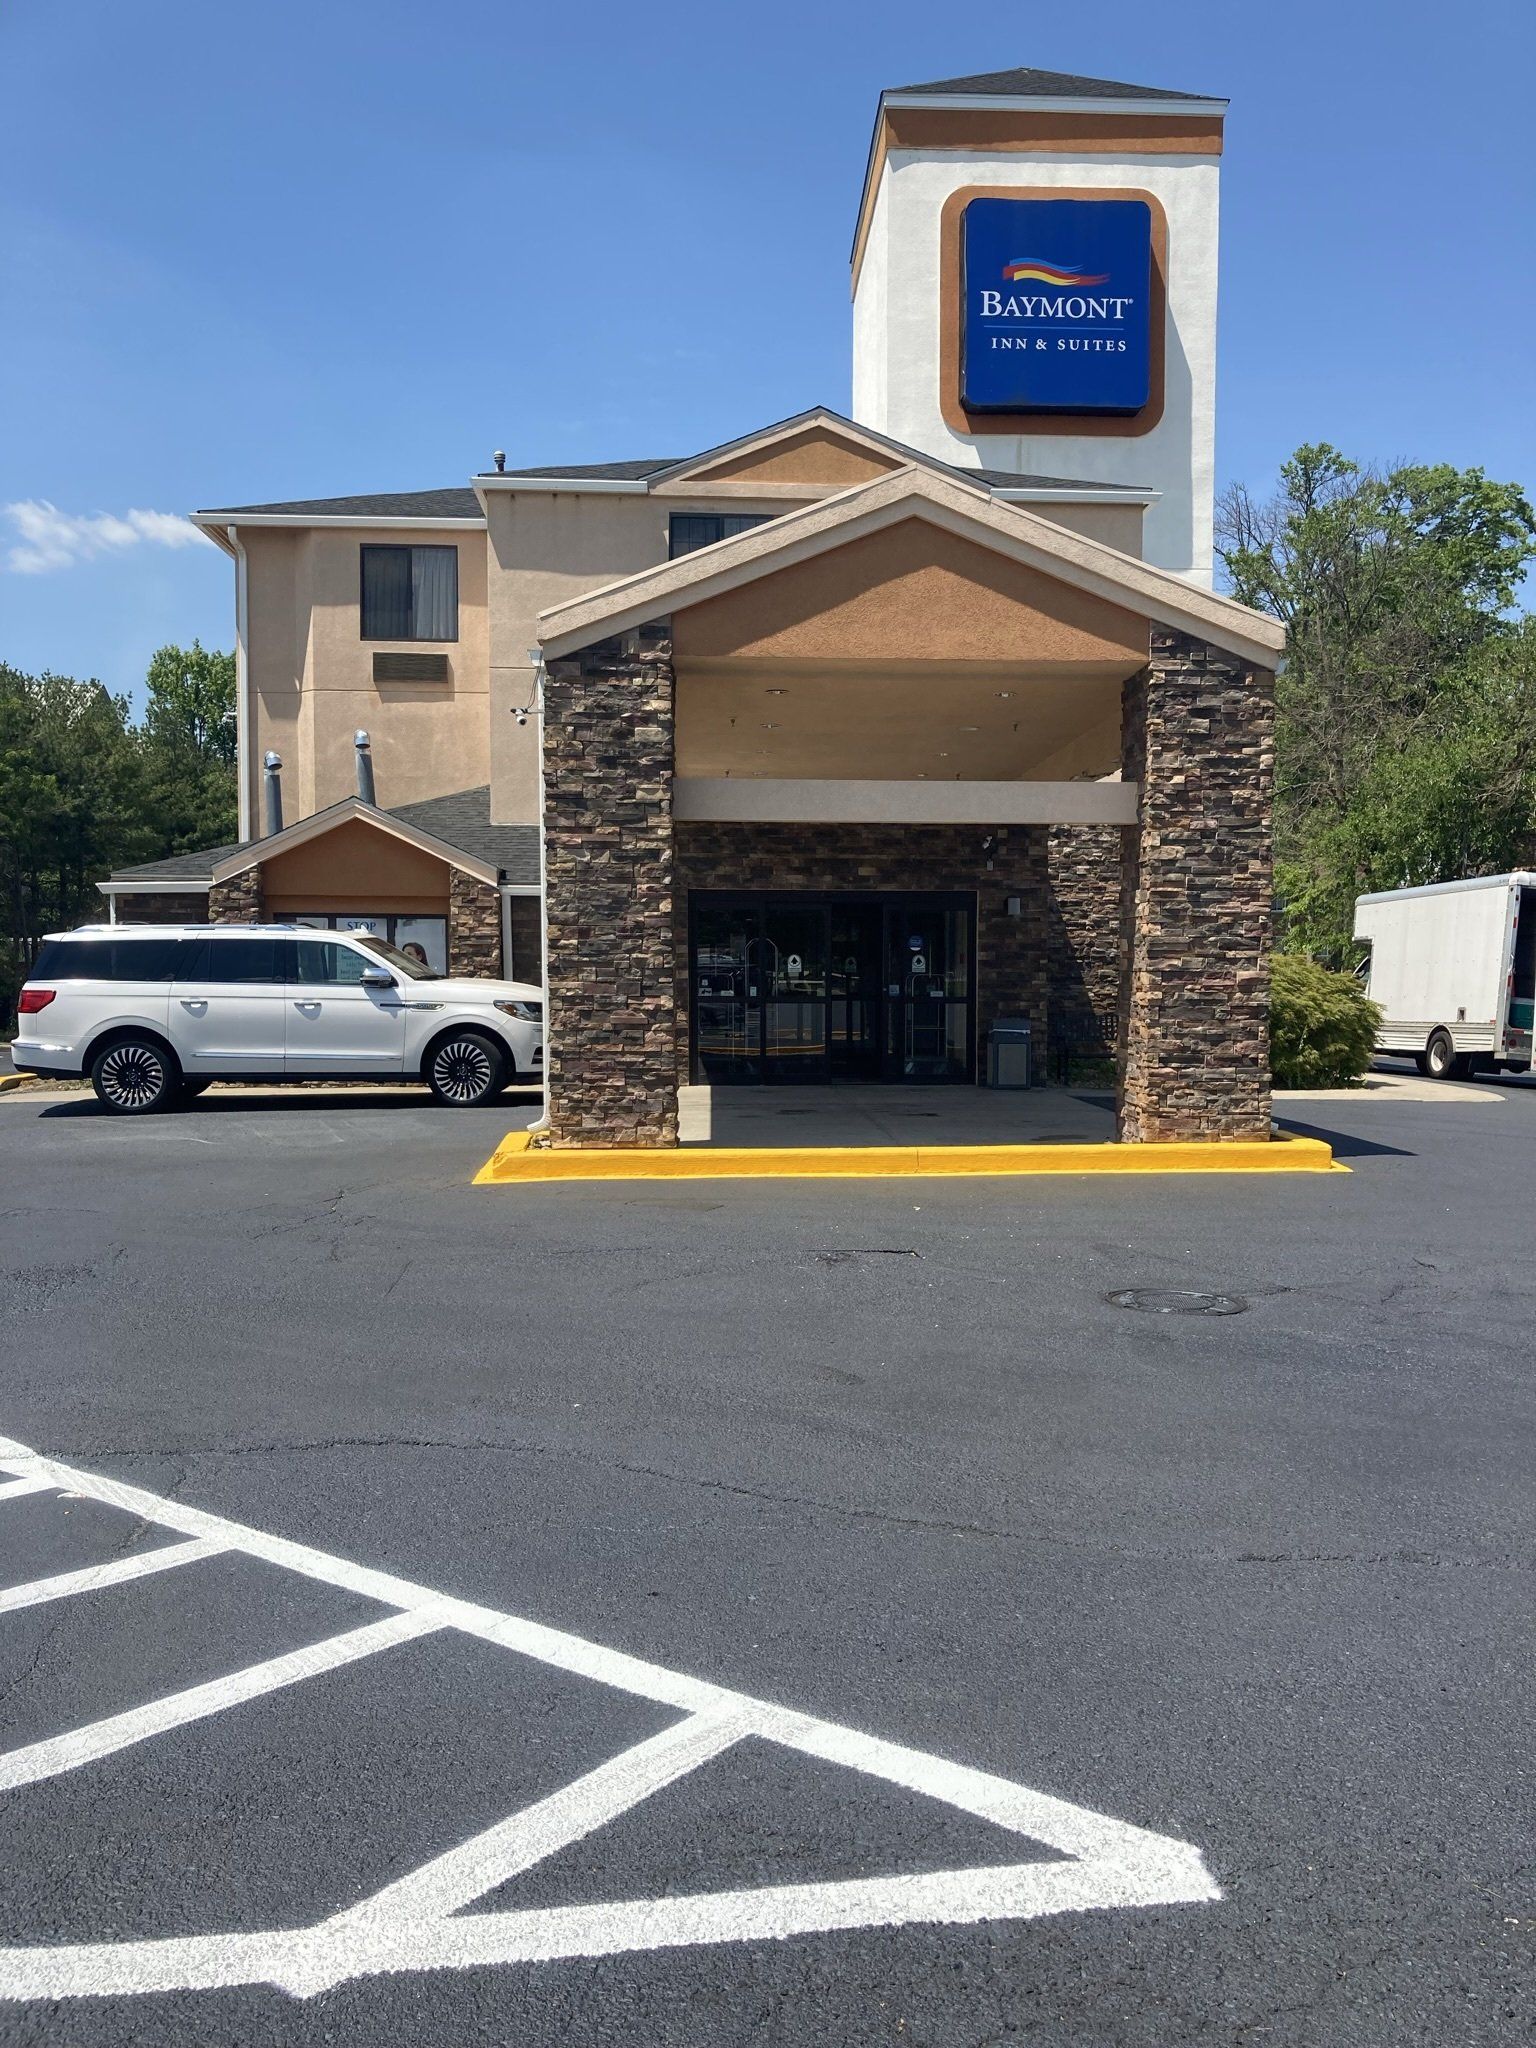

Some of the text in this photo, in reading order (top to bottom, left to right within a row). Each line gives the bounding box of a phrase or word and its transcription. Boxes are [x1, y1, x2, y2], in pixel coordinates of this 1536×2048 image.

[980, 290, 1129, 319] BAYMONT
[991, 337, 1127, 352] INN & SUITES
[347, 921, 377, 931] STOP
